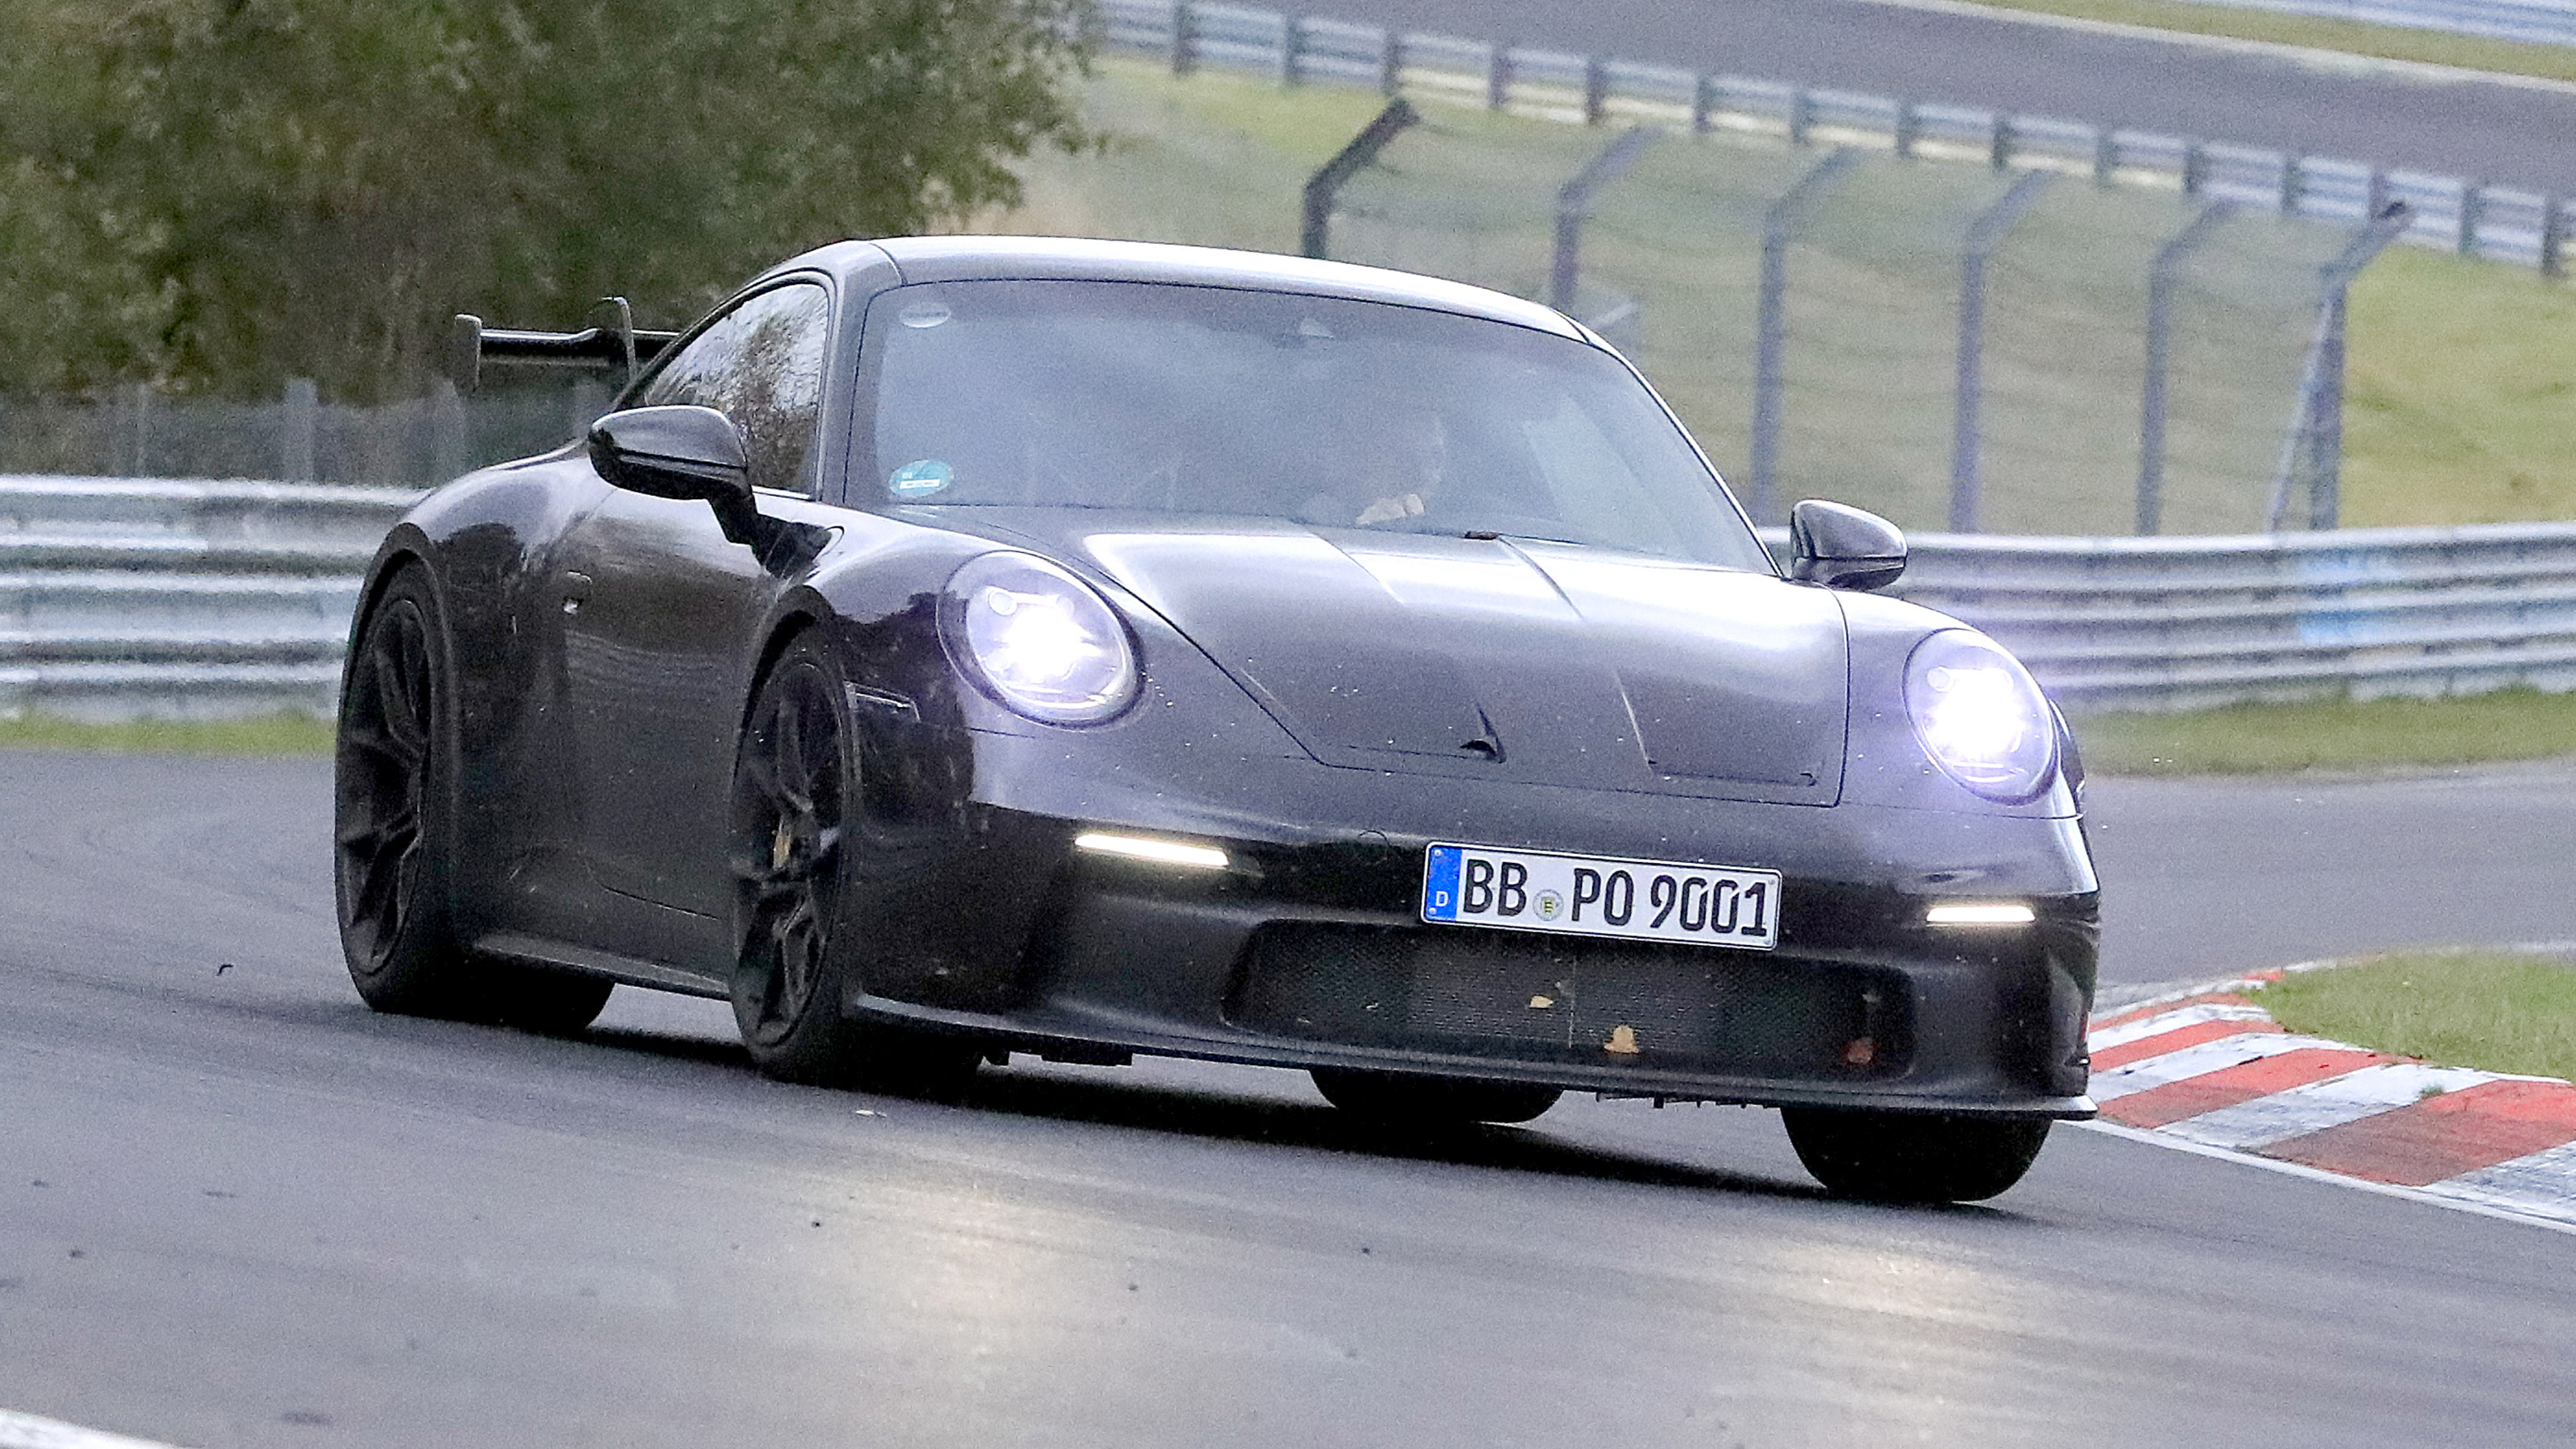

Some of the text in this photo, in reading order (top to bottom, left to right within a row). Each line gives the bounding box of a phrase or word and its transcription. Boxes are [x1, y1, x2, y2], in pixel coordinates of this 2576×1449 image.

[1435, 891, 1448, 907] D
[1463, 859, 1768, 937] BB PO 9001
